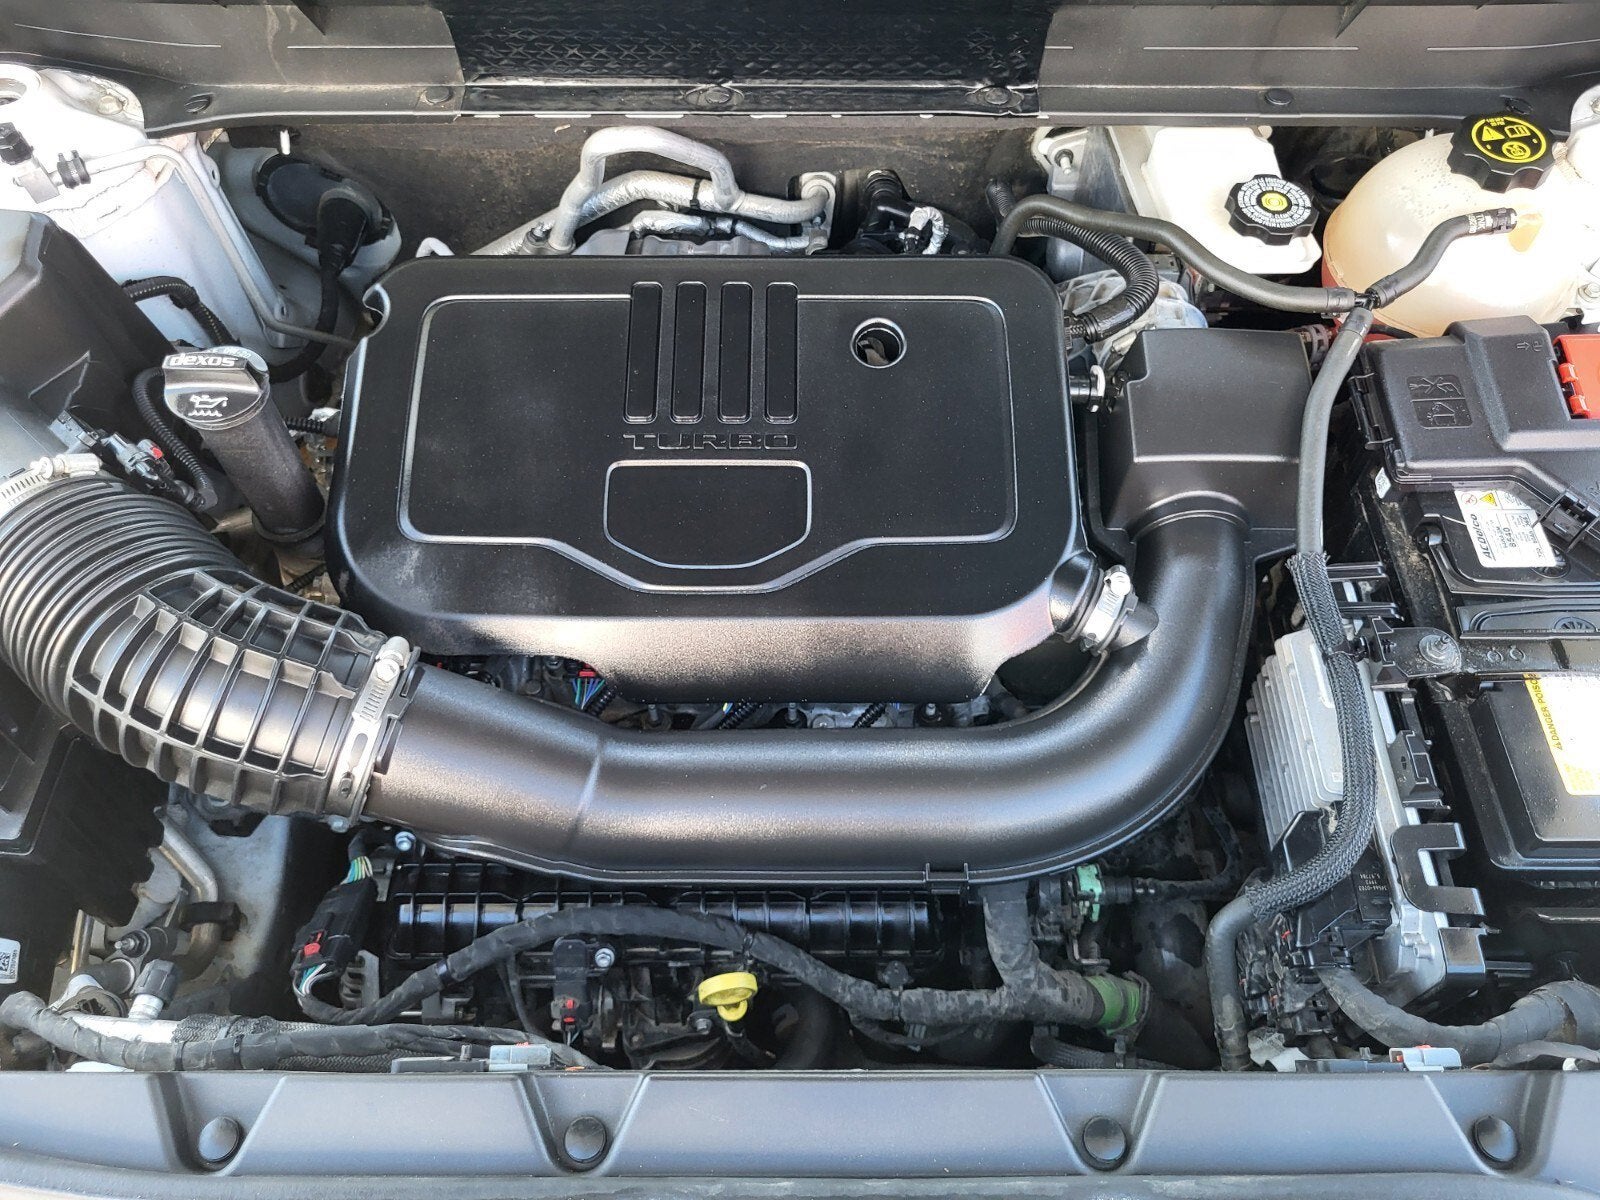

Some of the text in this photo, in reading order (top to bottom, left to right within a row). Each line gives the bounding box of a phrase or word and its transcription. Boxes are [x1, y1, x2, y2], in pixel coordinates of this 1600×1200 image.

[169, 353, 239, 367] dexos
[623, 433, 798, 450] TURBO
[1470, 513, 1492, 560] ACDelco
[1503, 527, 1517, 548] 8540
[1529, 678, 1560, 741] DANGER POISO
